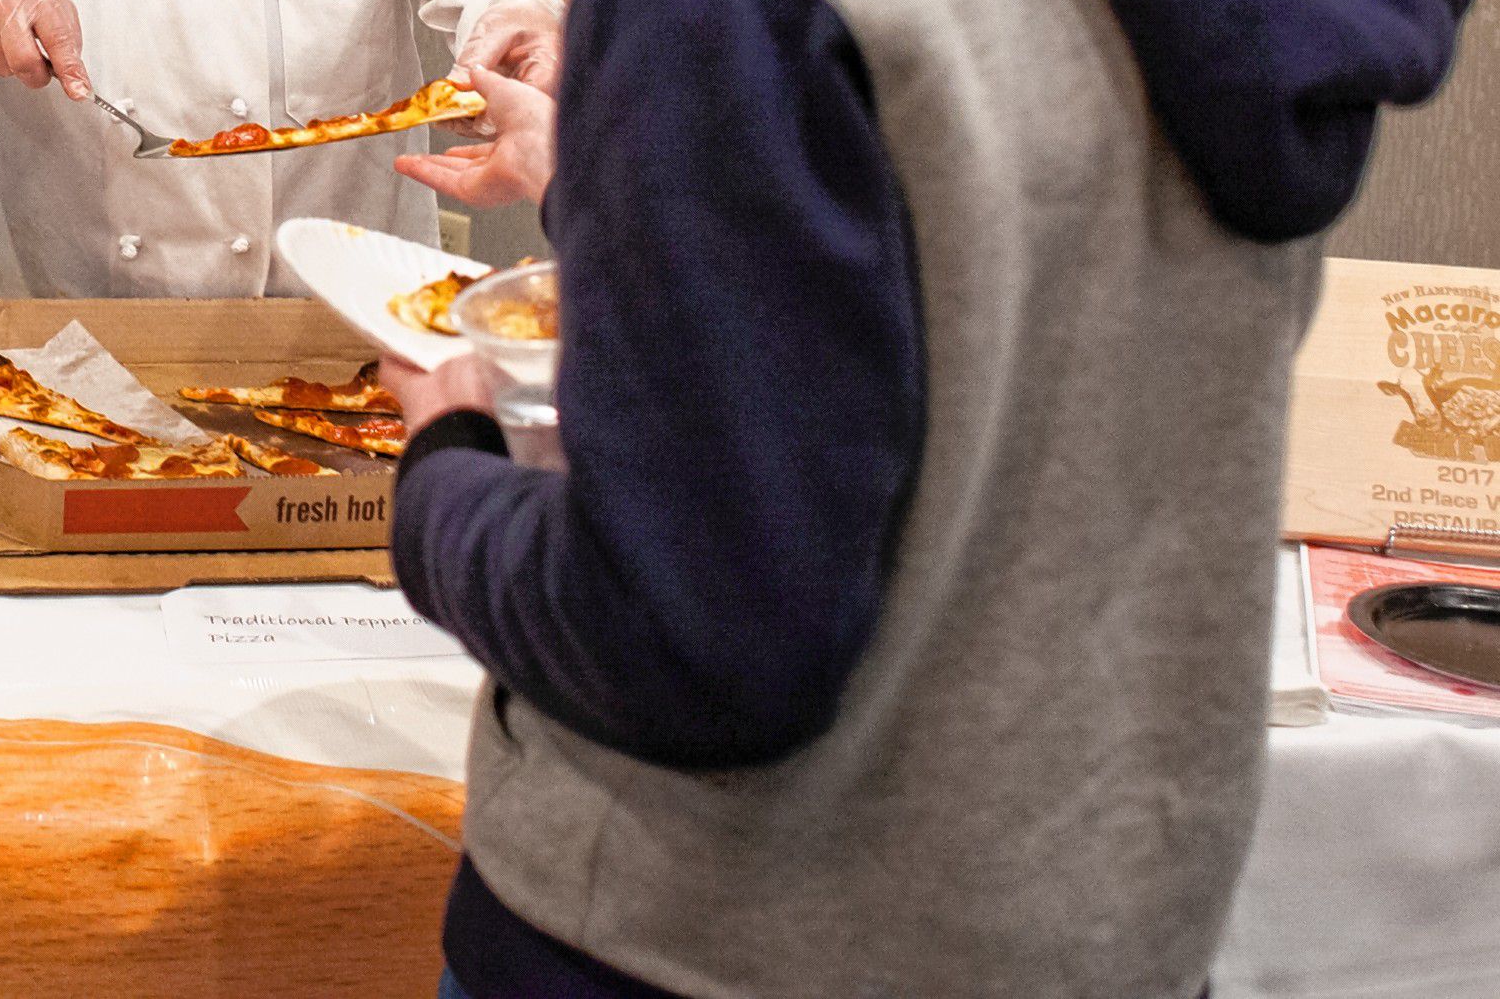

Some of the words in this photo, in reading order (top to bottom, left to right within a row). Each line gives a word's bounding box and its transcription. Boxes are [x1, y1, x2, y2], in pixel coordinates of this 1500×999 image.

[1437, 466, 1494, 486] 2017
[1371, 484, 1412, 503] 2nd
[1420, 488, 1478, 509] Place
[276, 496, 337, 523] fresh
[347, 495, 386, 521] hot
[204, 614, 336, 627] Traditional
[207, 633, 276, 644] Pizza
